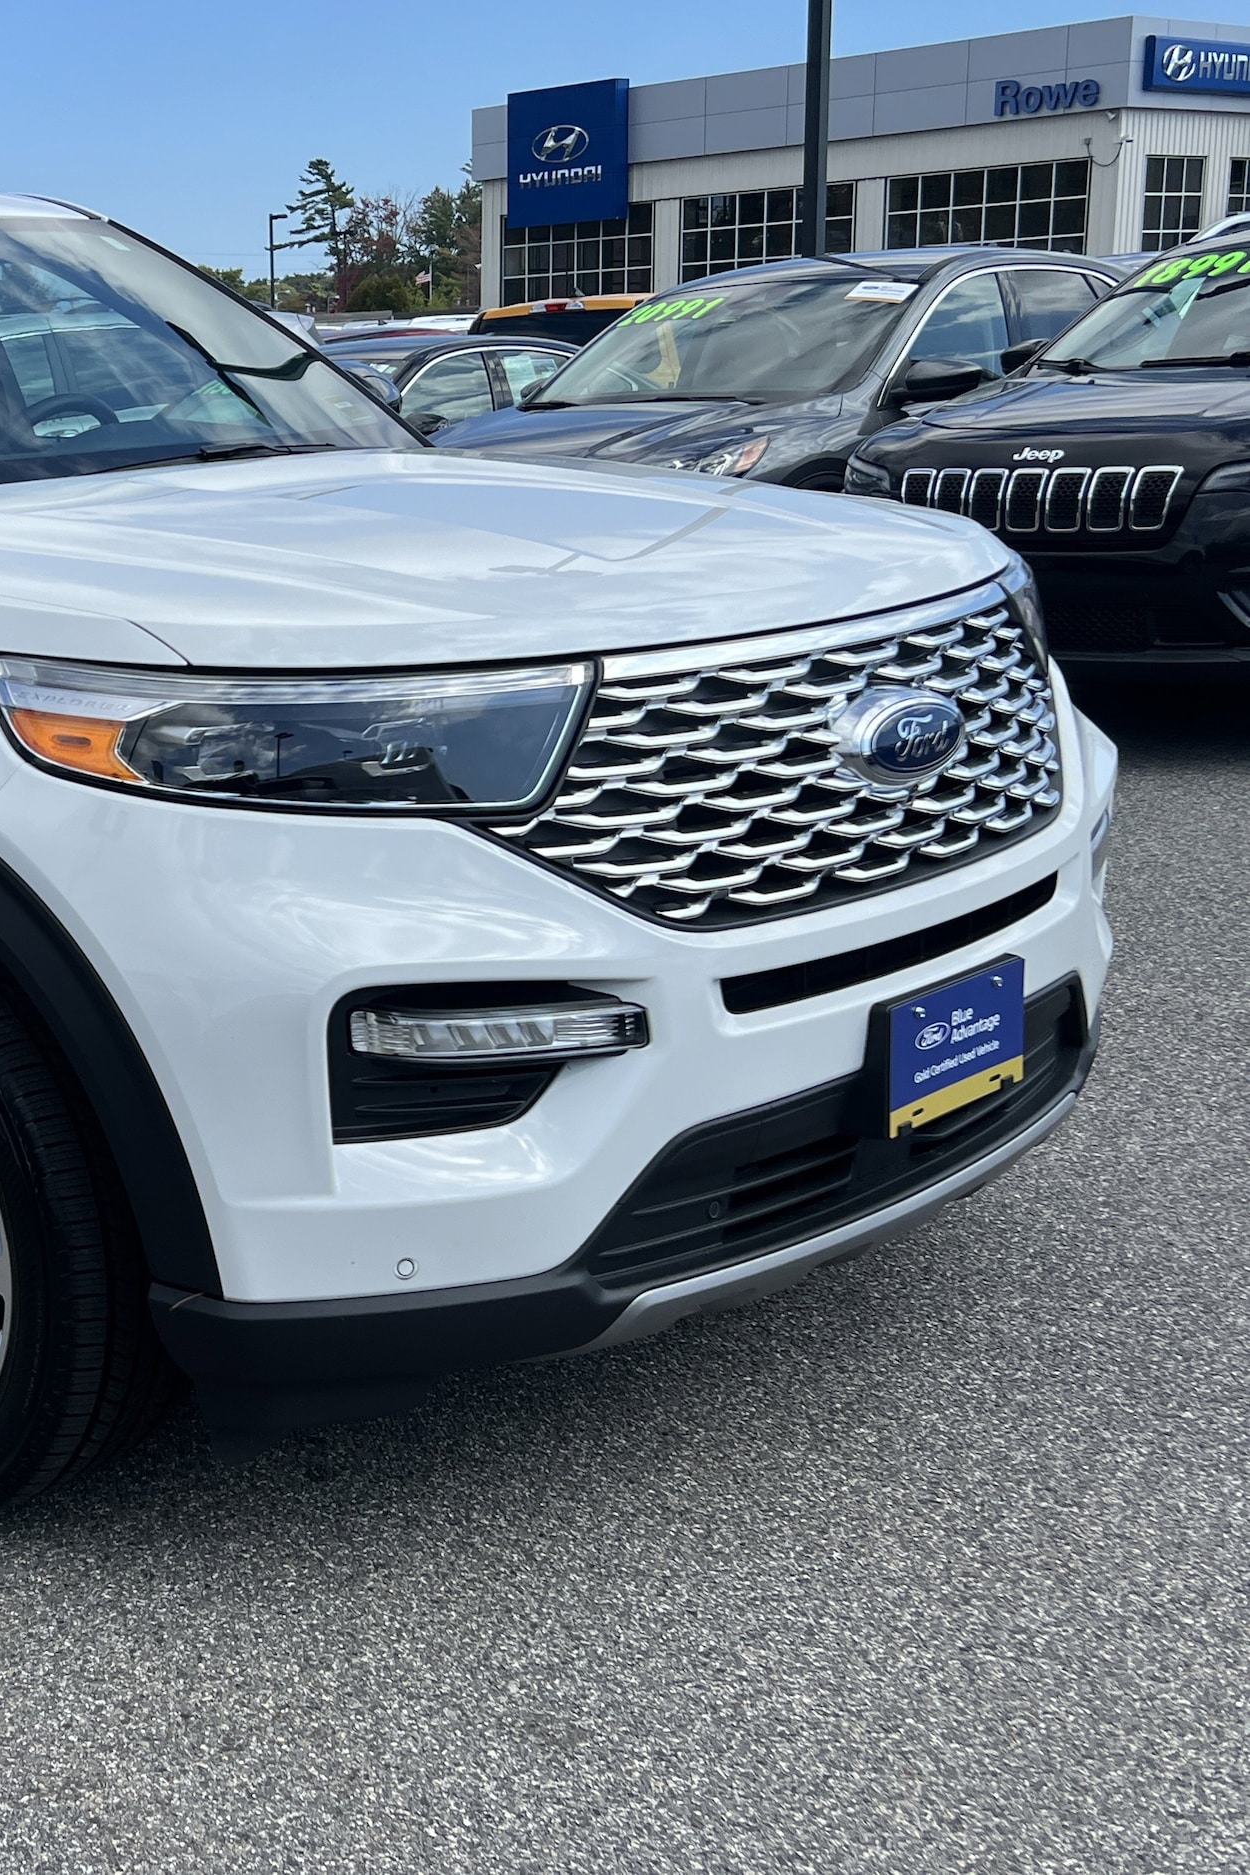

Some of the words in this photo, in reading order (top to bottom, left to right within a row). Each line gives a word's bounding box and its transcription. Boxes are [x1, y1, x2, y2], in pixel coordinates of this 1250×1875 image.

[1198, 50, 1250, 82] HYUN
[994, 78, 1100, 117] Rowe
[515, 163, 602, 190] HYUNDAI
[616, 297, 725, 328] 20991
[1012, 446, 1065, 463] Jeep
[12, 690, 132, 713] EXPLORER
[894, 713, 951, 762] Ford
[949, 1013, 1001, 1045] Advantage
[950, 1007, 974, 1026] Blue
[921, 1026, 945, 1046] Ford
[913, 1066, 932, 1084] Gold
[930, 1054, 959, 1077] Certified
[958, 1048, 977, 1064] Used
[976, 1039, 1000, 1057] Vehicle
